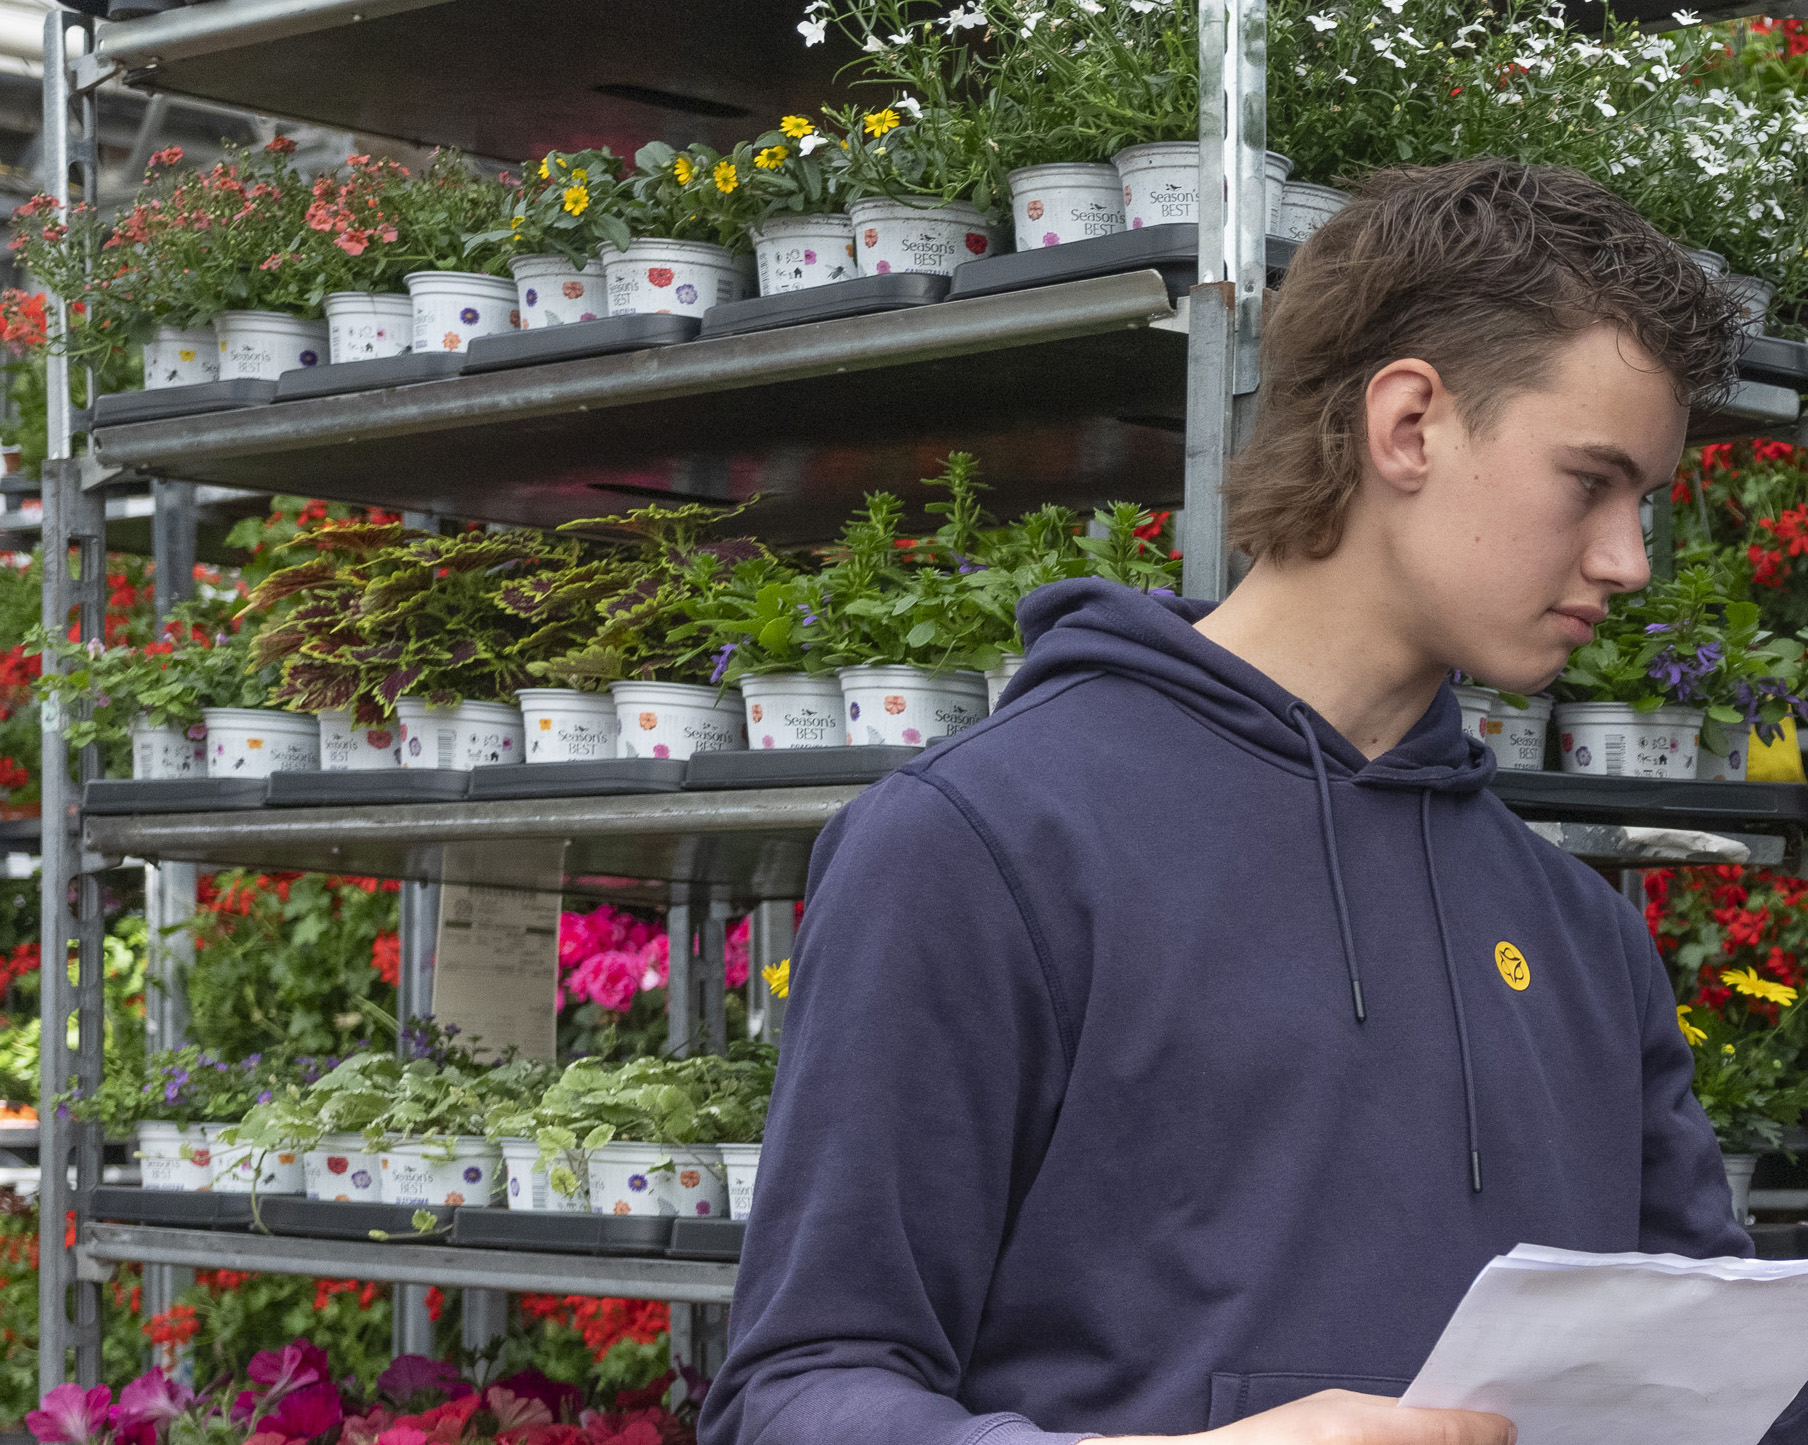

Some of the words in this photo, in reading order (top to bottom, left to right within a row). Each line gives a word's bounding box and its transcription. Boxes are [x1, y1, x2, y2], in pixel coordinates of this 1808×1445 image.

[1150, 190, 1199, 204] Season's
[1071, 210, 1126, 223] Season's
[1161, 204, 1190, 217] BEST
[1084, 223, 1115, 236] BEST
[902, 240, 955, 254] Season's
[914, 253, 943, 266] BEST
[784, 714, 836, 728] Season's
[558, 729, 607, 744] Season's
[684, 726, 732, 743] Season's
[796, 728, 825, 740] BEST
[569, 743, 596, 755] BEST
